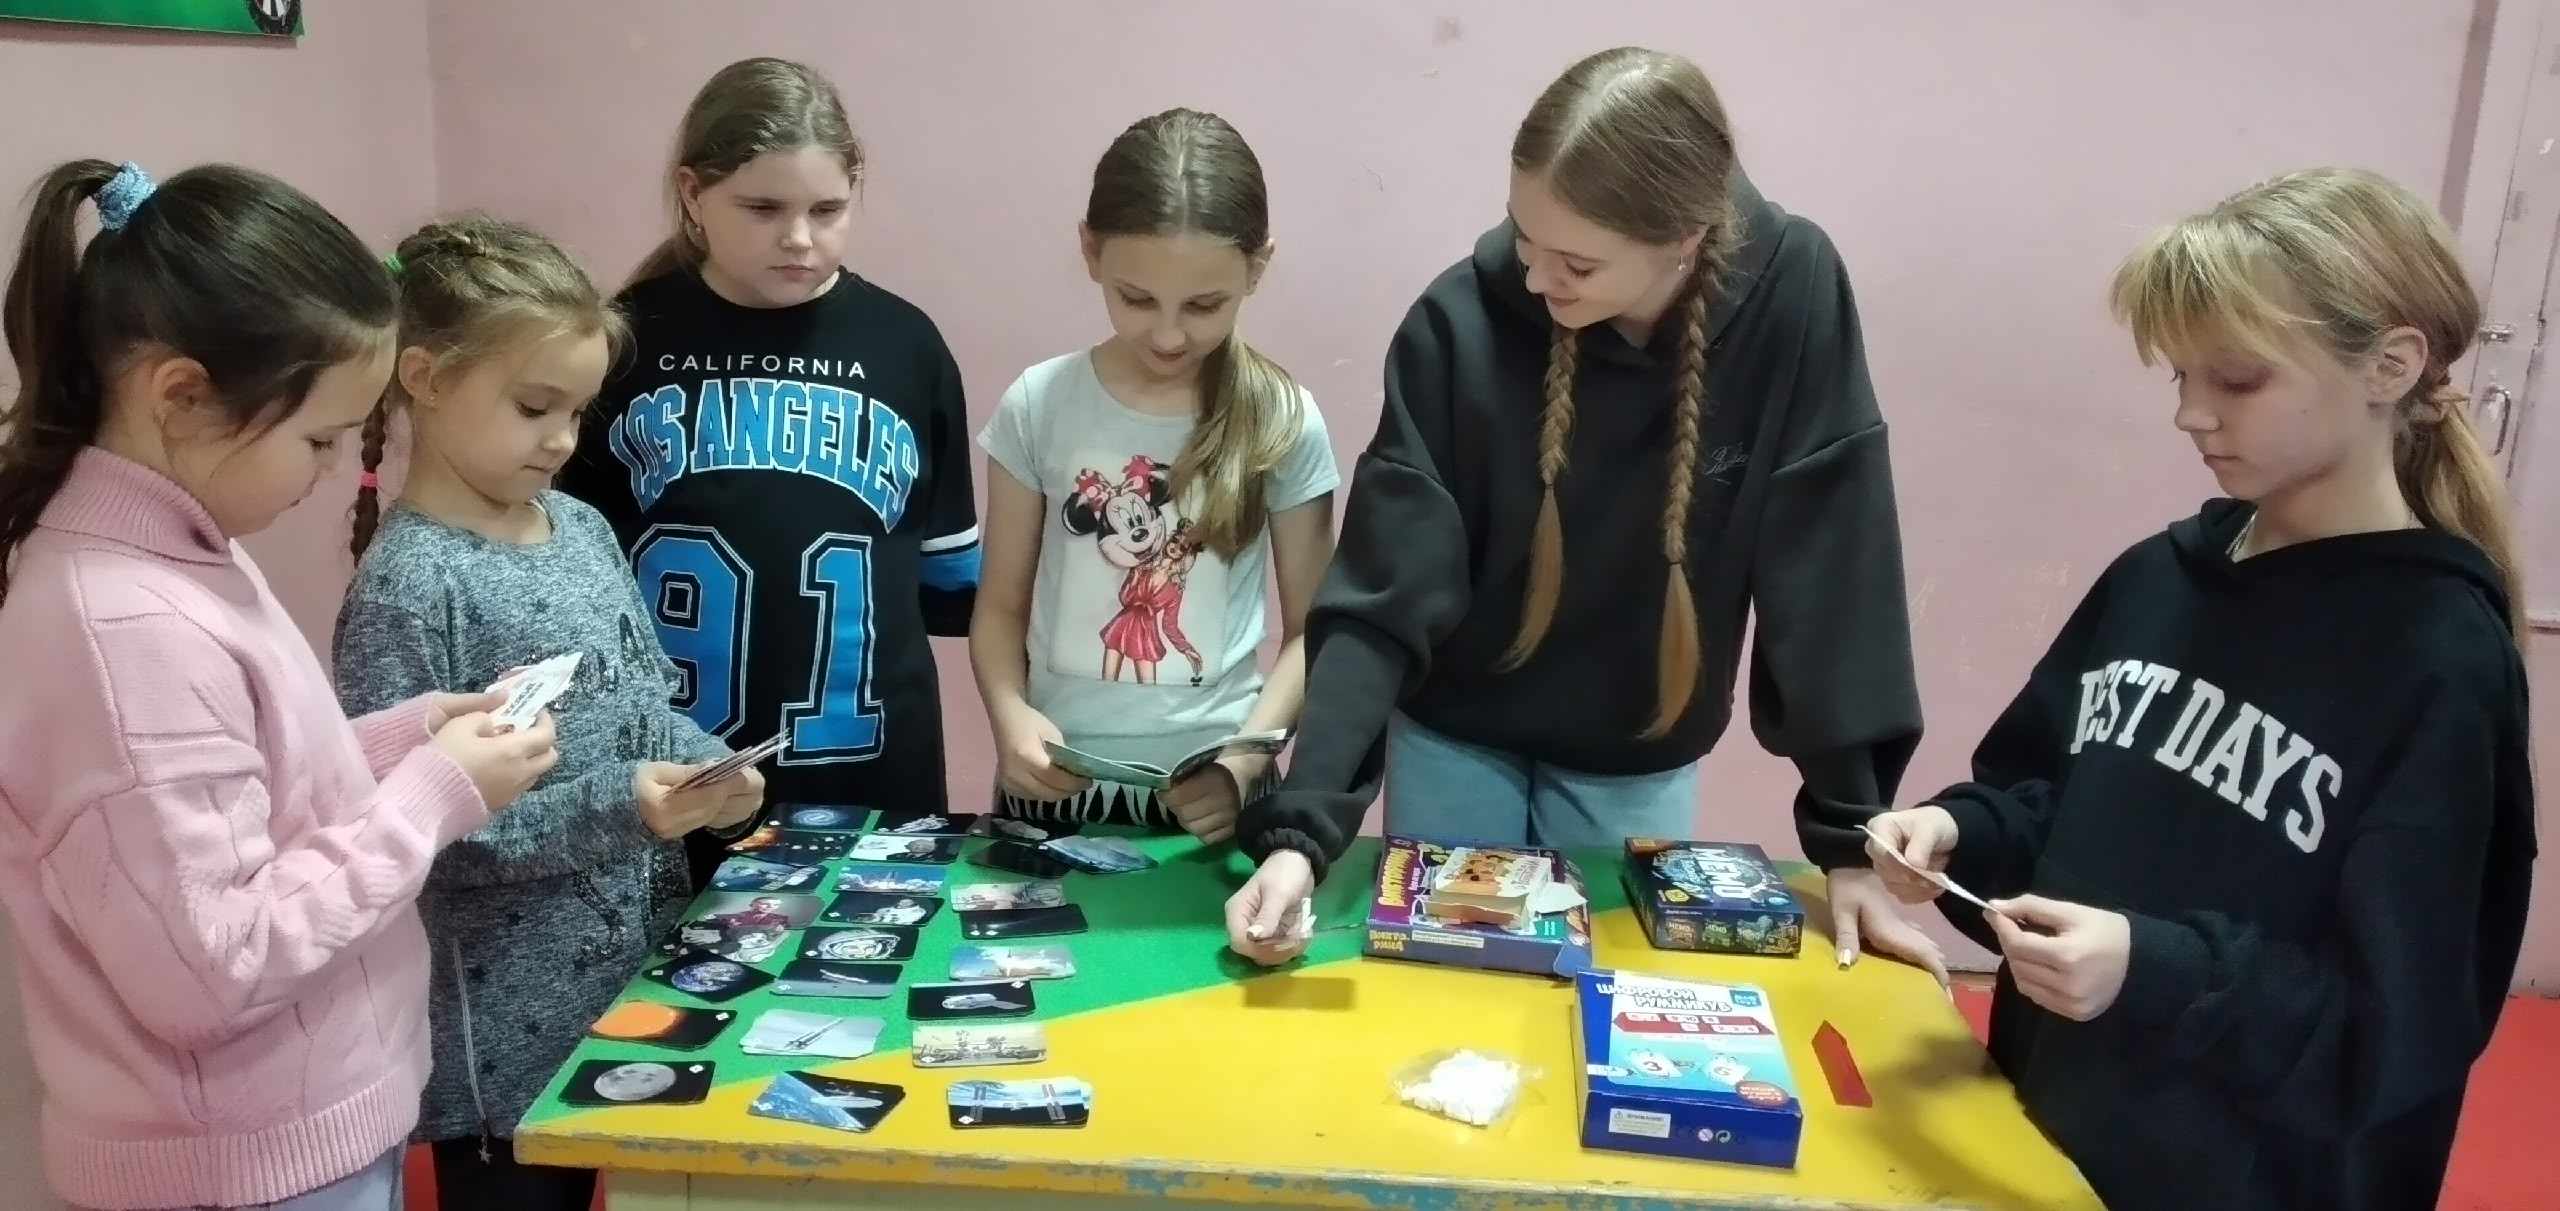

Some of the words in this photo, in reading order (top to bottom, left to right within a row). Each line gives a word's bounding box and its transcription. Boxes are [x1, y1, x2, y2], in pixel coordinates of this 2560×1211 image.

[658, 353, 866, 379] CALIFORNIA
[689, 377, 919, 535] ANGELES
[629, 523, 886, 766] 91
[2153, 677, 2343, 854] DAYS
